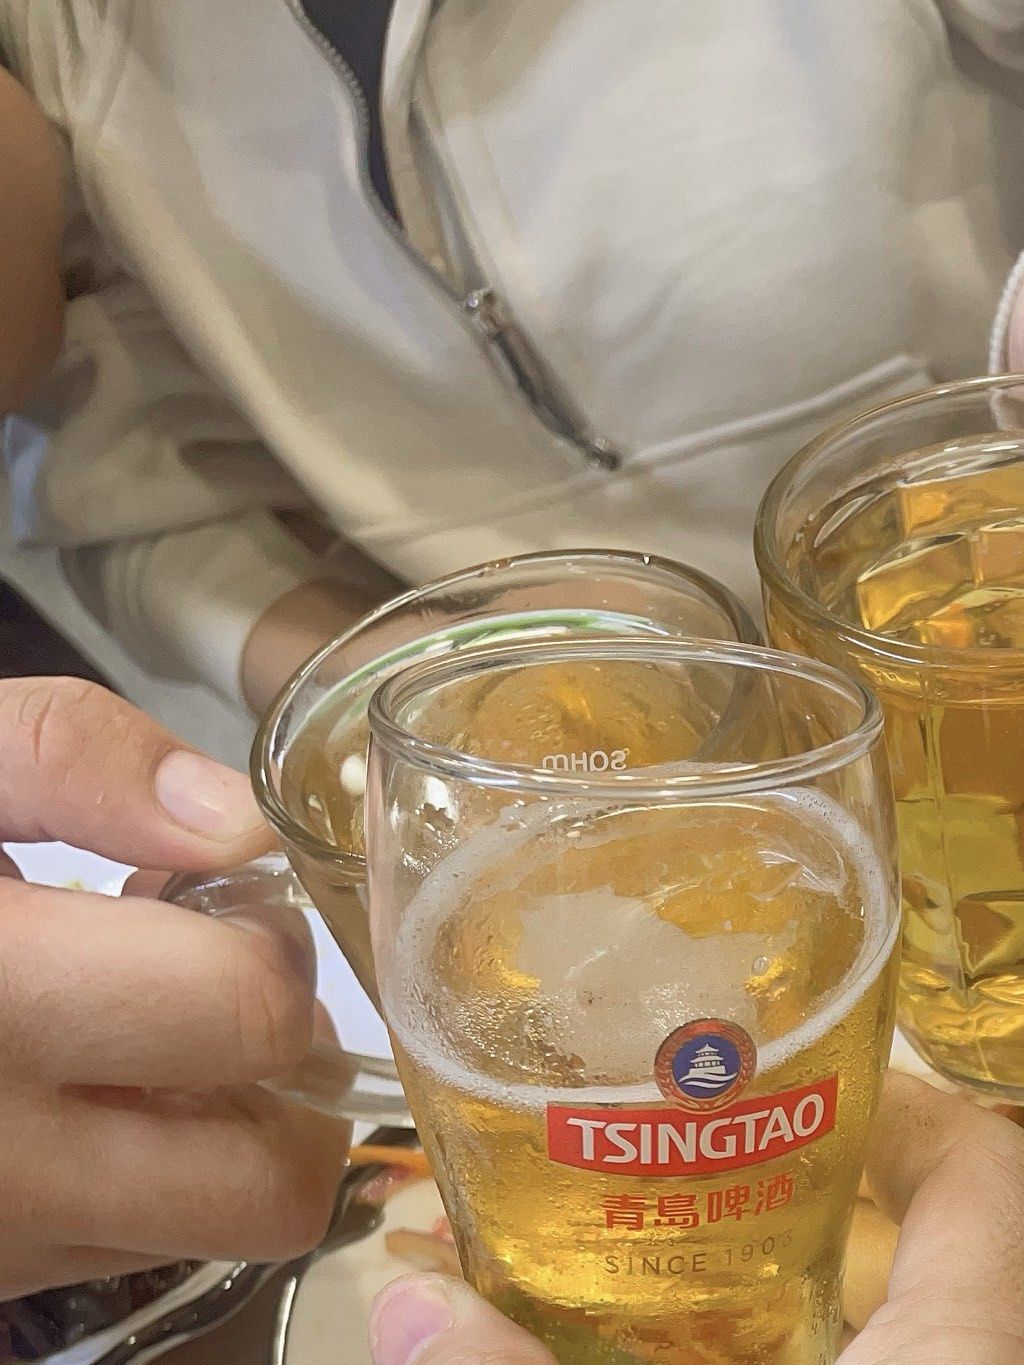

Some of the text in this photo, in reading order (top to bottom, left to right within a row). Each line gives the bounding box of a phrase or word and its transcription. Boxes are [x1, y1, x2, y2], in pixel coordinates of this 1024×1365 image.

[566, 1093, 825, 1165] TSINGTAO
[600, 1173, 796, 1231] 青島啤酒
[603, 1252, 708, 1276] SINCE
